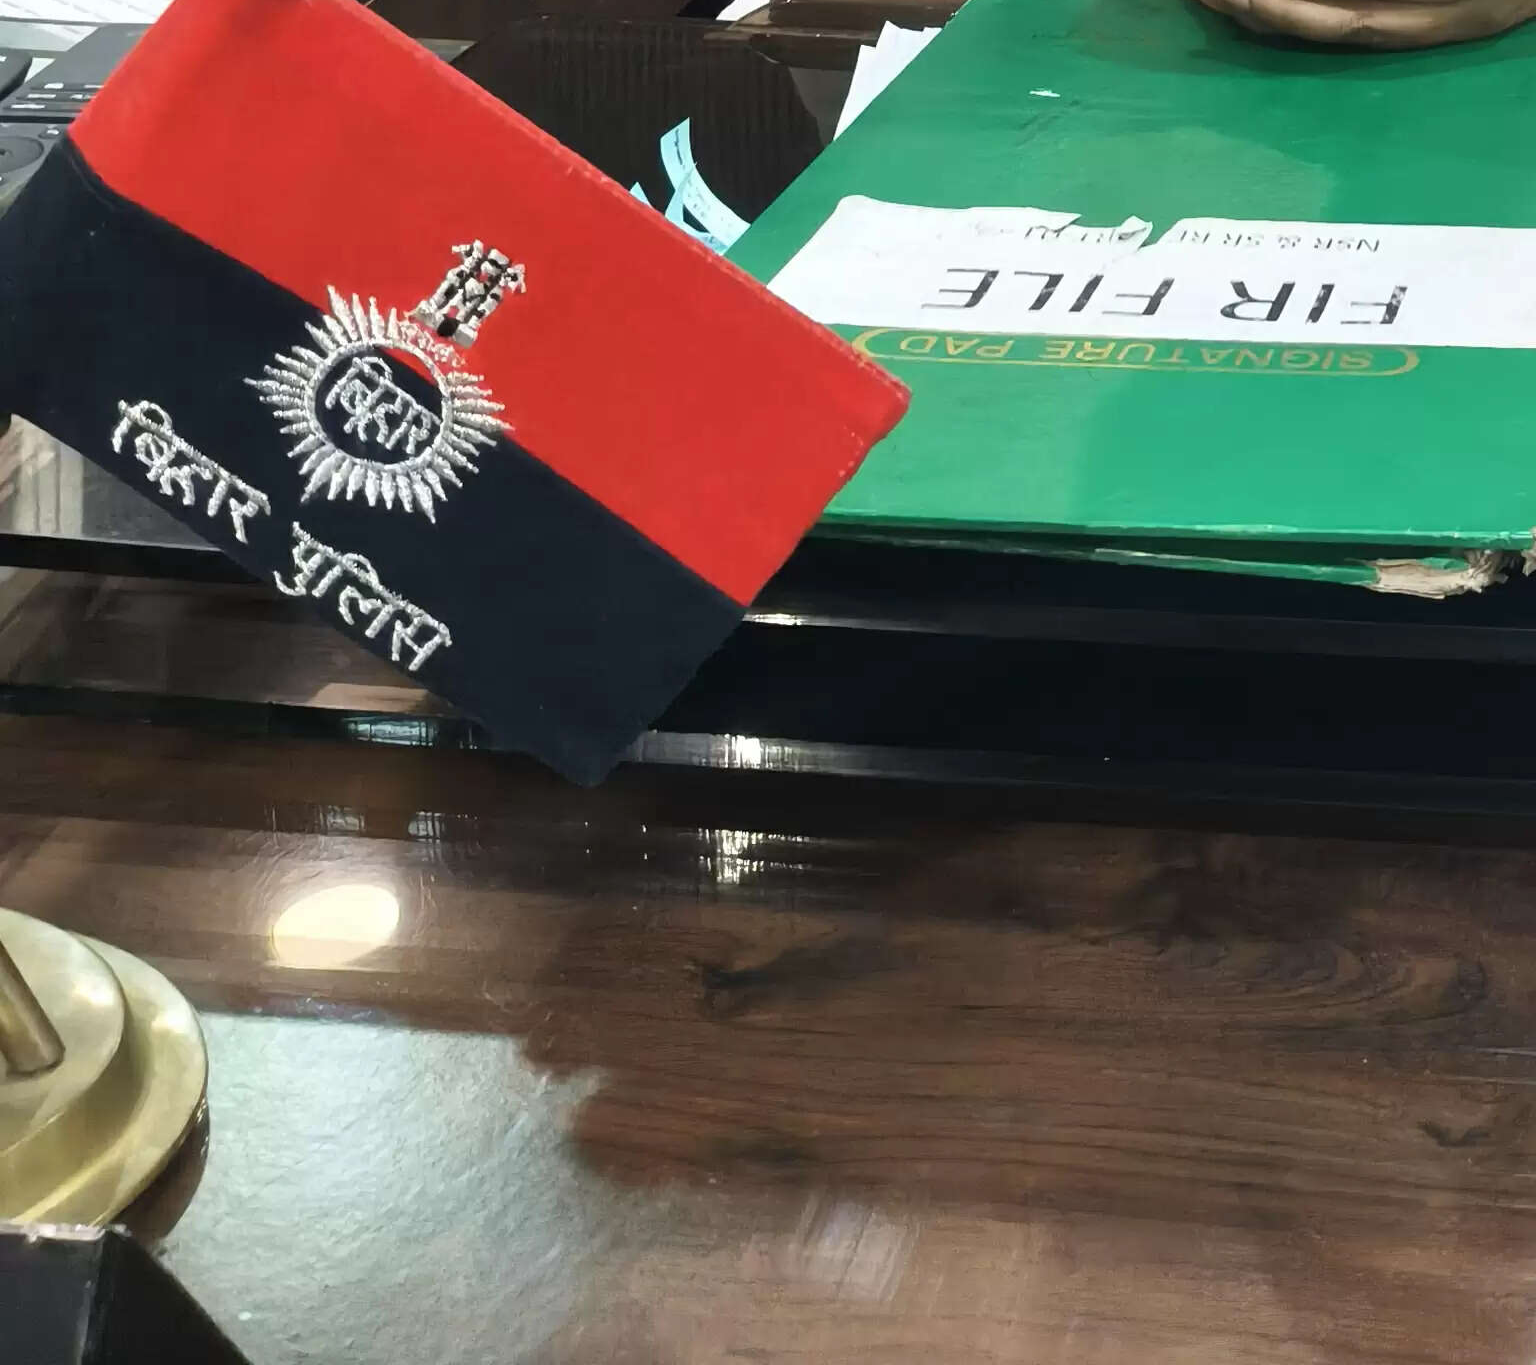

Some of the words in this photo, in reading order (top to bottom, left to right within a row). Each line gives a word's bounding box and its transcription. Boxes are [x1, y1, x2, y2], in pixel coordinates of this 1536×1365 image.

[921, 269, 1175, 316] FILE
[1219, 281, 1408, 325] FIR
[899, 335, 1015, 358] PAD
[1038, 339, 1375, 372] SIGNATURE
[272, 521, 453, 672] पुलिस
